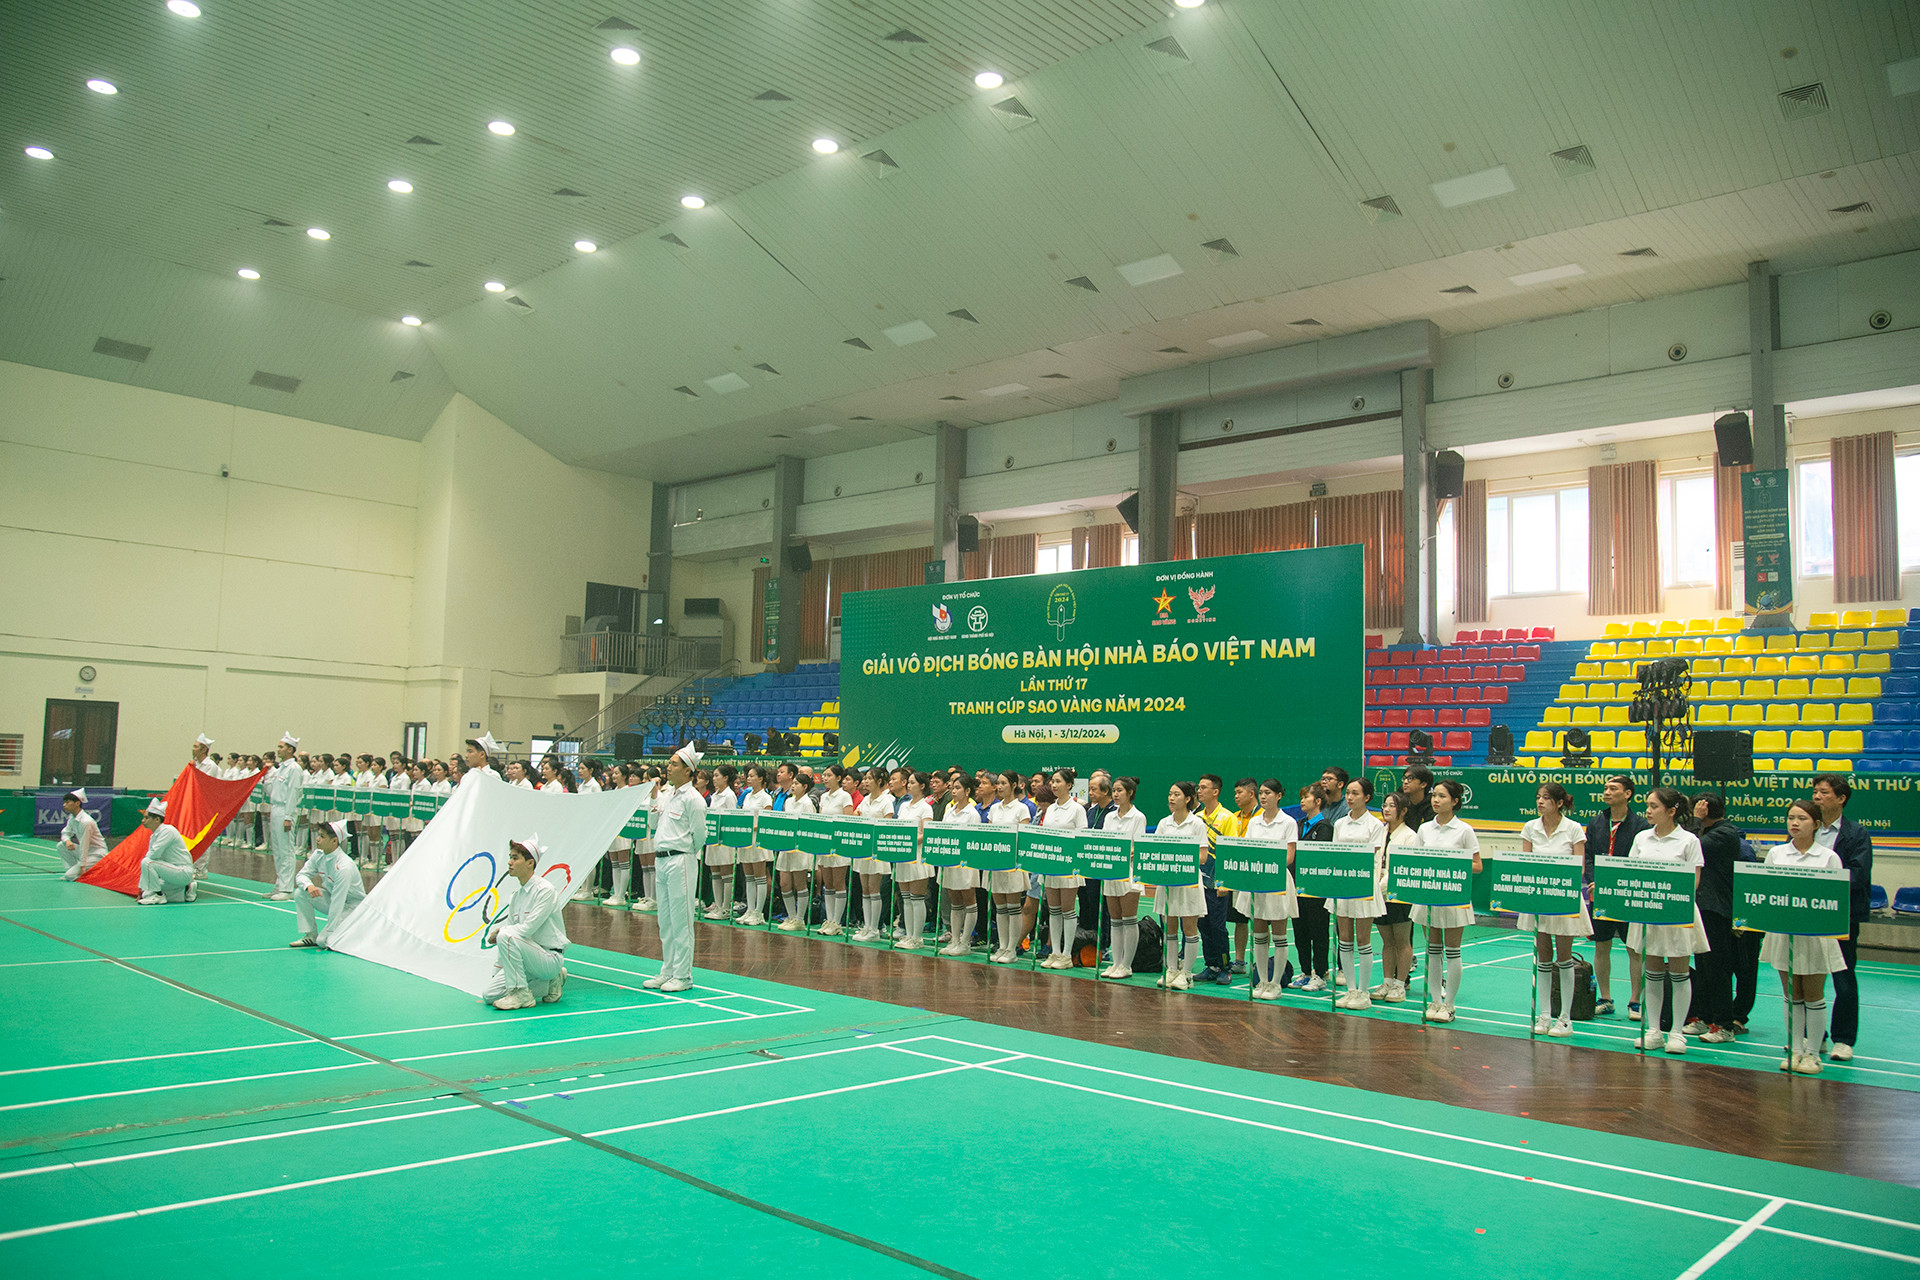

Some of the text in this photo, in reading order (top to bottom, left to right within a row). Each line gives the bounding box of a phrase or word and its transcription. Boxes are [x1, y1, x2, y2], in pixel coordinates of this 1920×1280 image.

[1177, 571, 1194, 580] ĐỒNG
[862, 635, 1315, 677] GIẢI VÔ ĐỊCH BÓNG BÀN HỘI NHÀ BÁO VIỆT NAM
[1020, 675, 1088, 692] LẦN THỨ 17
[949, 694, 1186, 715] TRANH CÚP SAO VÀNG NĂM 2024
[1014, 729, 1026, 738] Hà
[1028, 729, 1046, 740] Nội,
[1048, 729, 1052, 738] 1
[1060, 729, 1106, 739] 3/12/2024
[1488, 770, 1515, 784] GIẢI
[1517, 771, 1536, 784] VÔ
[1540, 773, 1572, 786] ĐỊCH
[1753, 773, 1789, 790] VIỆT
[1874, 776, 1912, 791] THỨ
[1732, 794, 1764, 807] NĂM
[967, 841, 1011, 853] BÁO LAO ĐỘNG
[1140, 853, 1150, 861] TẠP
[1151, 852, 1160, 860] CHÍ
[1170, 863, 1181, 874] VIỆT
[1224, 859, 1278, 874] BÁO HÀ NỘI MỚI
[1300, 868, 1308, 876] TẠP
[1357, 868, 1370, 878] SỐNG
[1393, 865, 1467, 880] LIÊN CHI HỘI NHÀ BÁO
[1397, 878, 1462, 892] NGÀNH NGÂN HÀNG
[1512, 874, 1522, 884] HỘI
[1523, 875, 1535, 883] NHÀ
[1536, 876, 1548, 884] BÁO
[1550, 878, 1560, 887] TẠP
[1562, 878, 1572, 886] CHÍ
[1630, 879, 1641, 889] HỘI
[1643, 881, 1656, 889] NHÀ
[1658, 882, 1671, 890] BÁO
[1494, 884, 1513, 892] DOANH
[1514, 885, 1535, 895] NGHIỆP
[1543, 888, 1565, 897] THƯƠNG
[1567, 890, 1578, 899] MẠI
[1614, 888, 1632, 897] THIẾU
[1667, 893, 1690, 902] PHONG
[1744, 893, 1838, 910] TẠP CHÍ DA CAM
